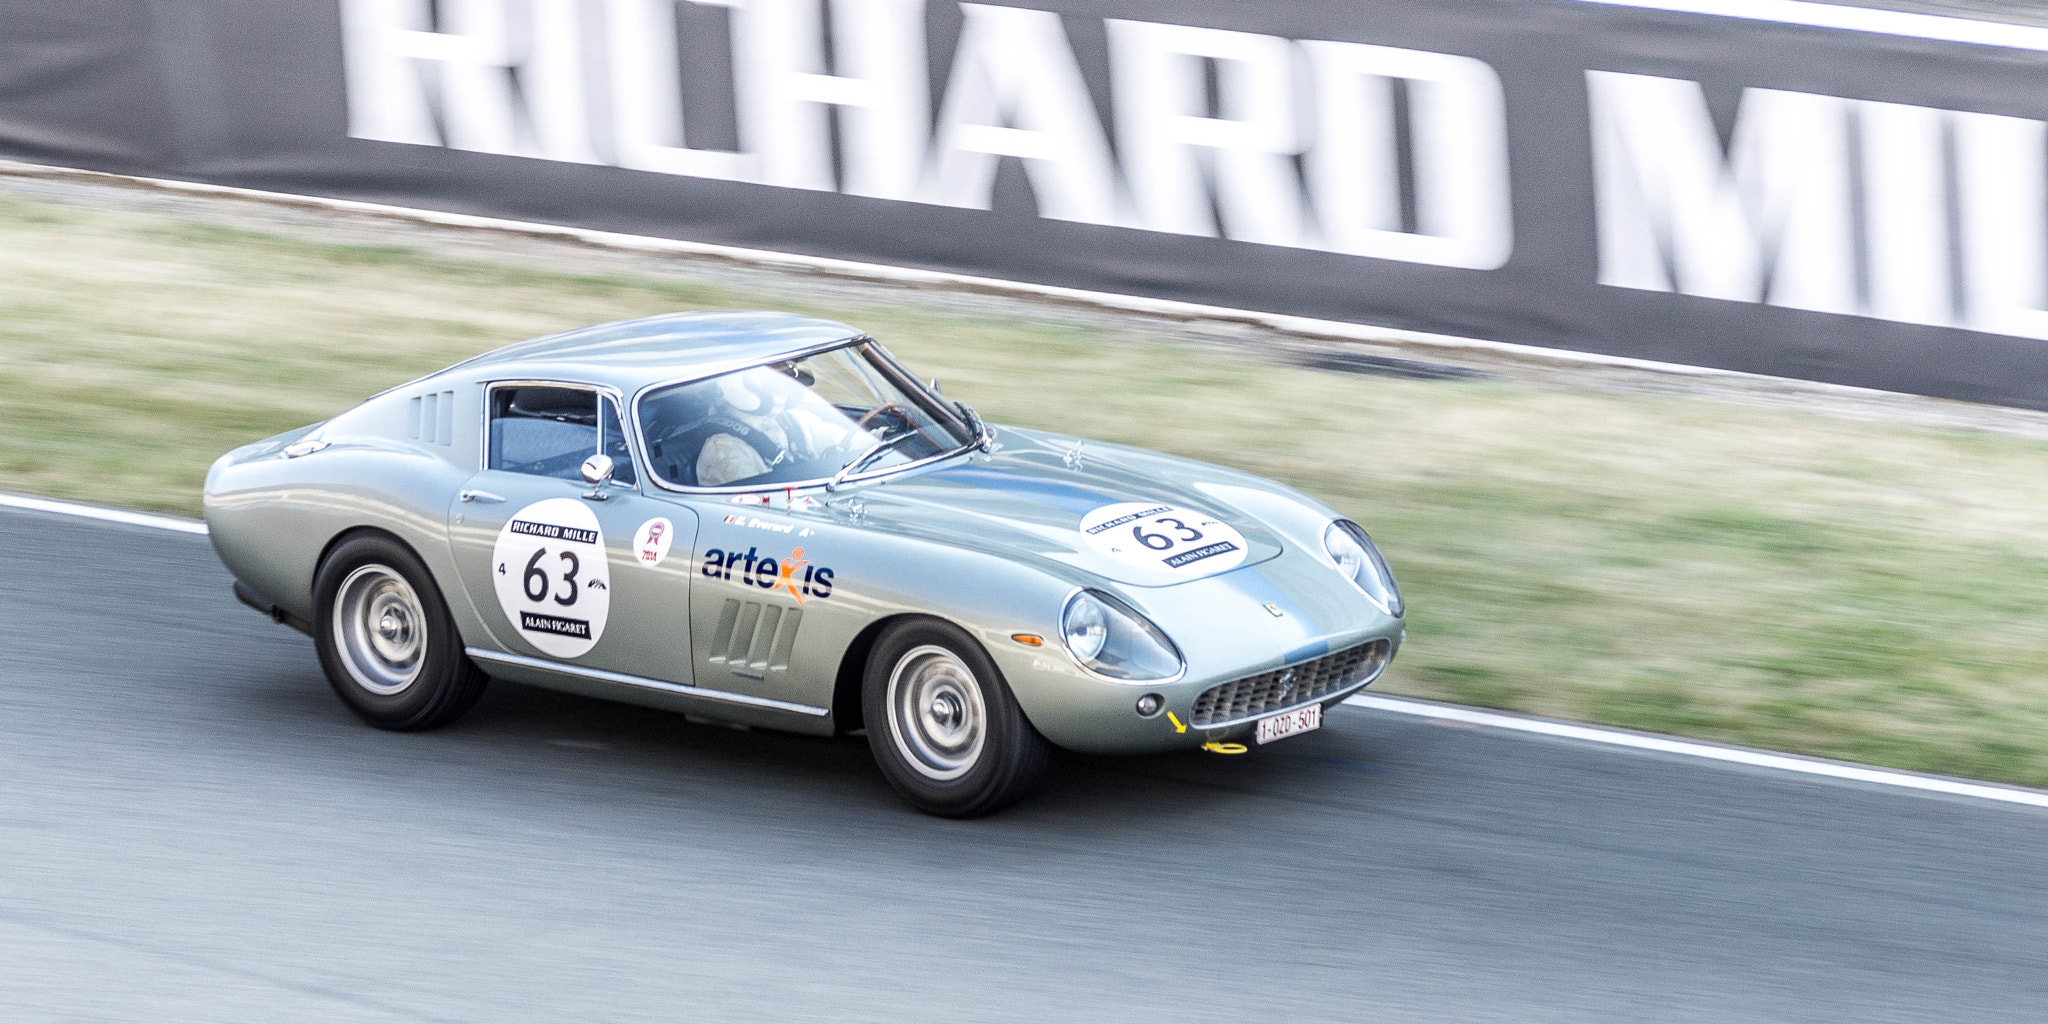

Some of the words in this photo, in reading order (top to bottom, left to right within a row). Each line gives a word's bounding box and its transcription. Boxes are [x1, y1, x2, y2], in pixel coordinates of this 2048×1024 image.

[338, 0, 1514, 271] RICHARD
[512, 521, 560, 537] RICHARD
[563, 528, 596, 543] MILLE
[1133, 518, 1203, 551] 63
[498, 562, 506, 576] 4
[1171, 551, 1198, 566] ALAIN
[523, 547, 580, 606] 63
[702, 547, 834, 605] artexis
[525, 616, 551, 630] ALAIN
[552, 620, 587, 635] FIGARET
